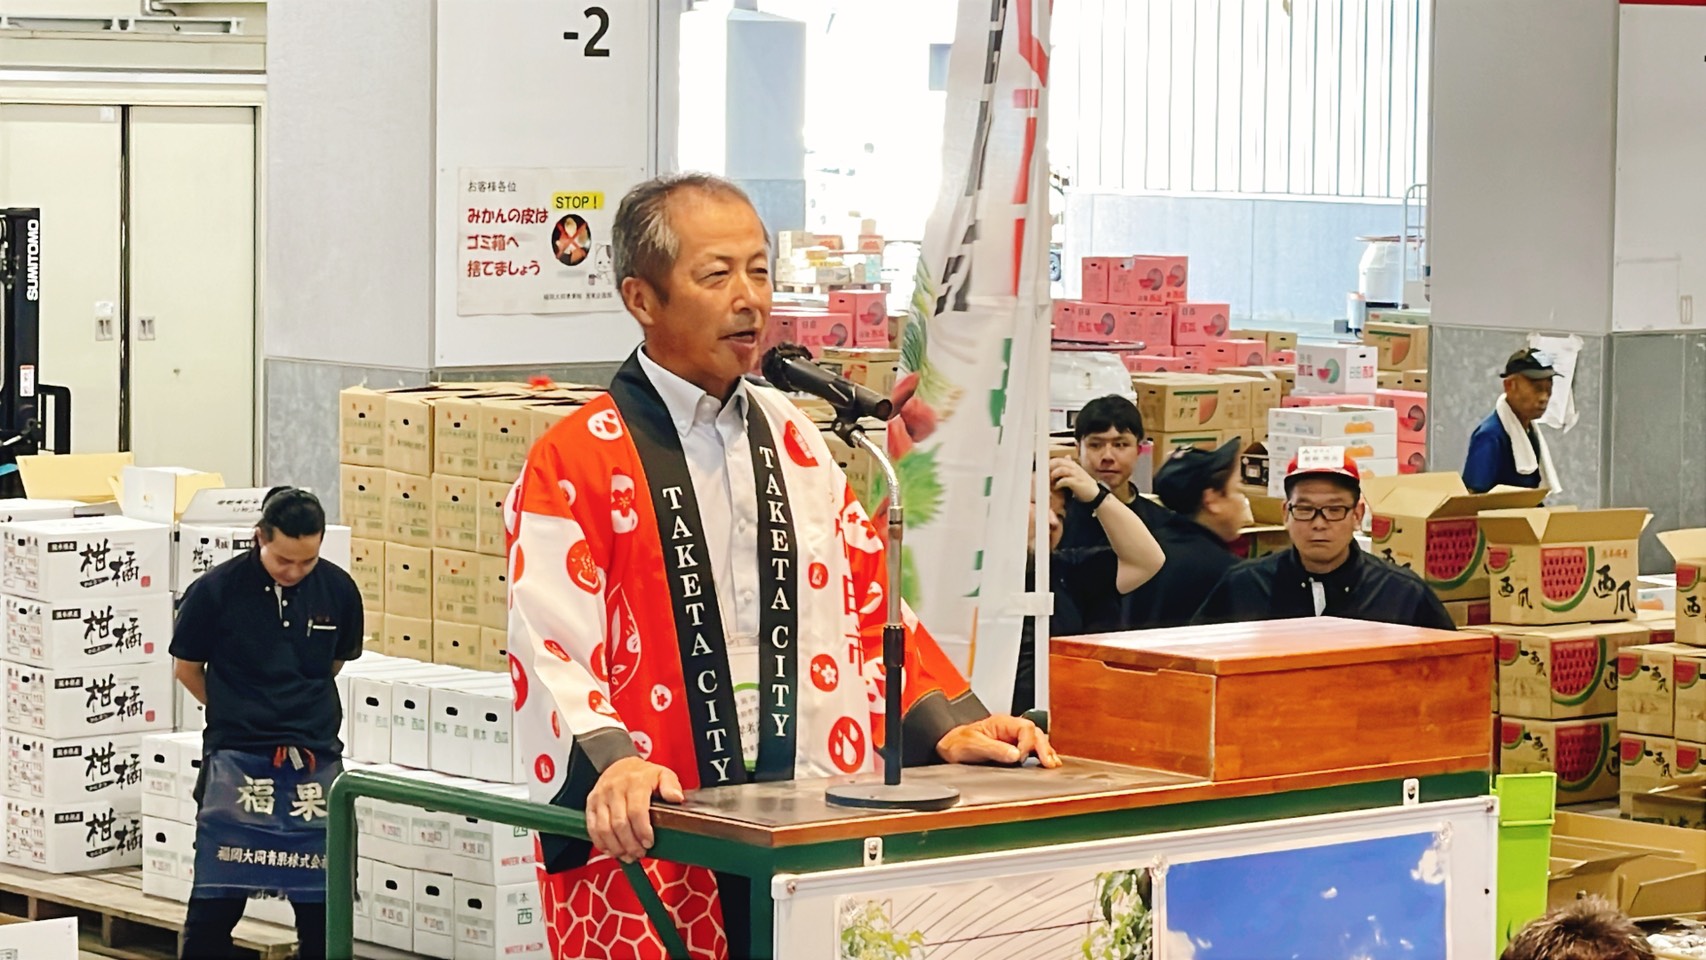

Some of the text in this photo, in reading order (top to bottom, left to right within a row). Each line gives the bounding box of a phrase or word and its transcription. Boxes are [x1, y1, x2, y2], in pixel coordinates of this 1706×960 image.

[563, 6, 610, 57] -2
[467, 180, 517, 192] お客様各位
[467, 208, 549, 224] みかんの皮は
[27, 219, 40, 301] SUMITOMO
[467, 234, 520, 251] ゴミ箱へ
[467, 260, 541, 277] 捨てましょう
[79, 538, 140, 588] 柑橘
[758, 445, 791, 737] TAKETA CITY
[83, 605, 142, 655] 柑橘
[662, 486, 731, 783] TAKETA CITY
[85, 673, 144, 722] 柑橘
[84, 741, 142, 790] 柑橘
[85, 807, 143, 856] 柑橘
